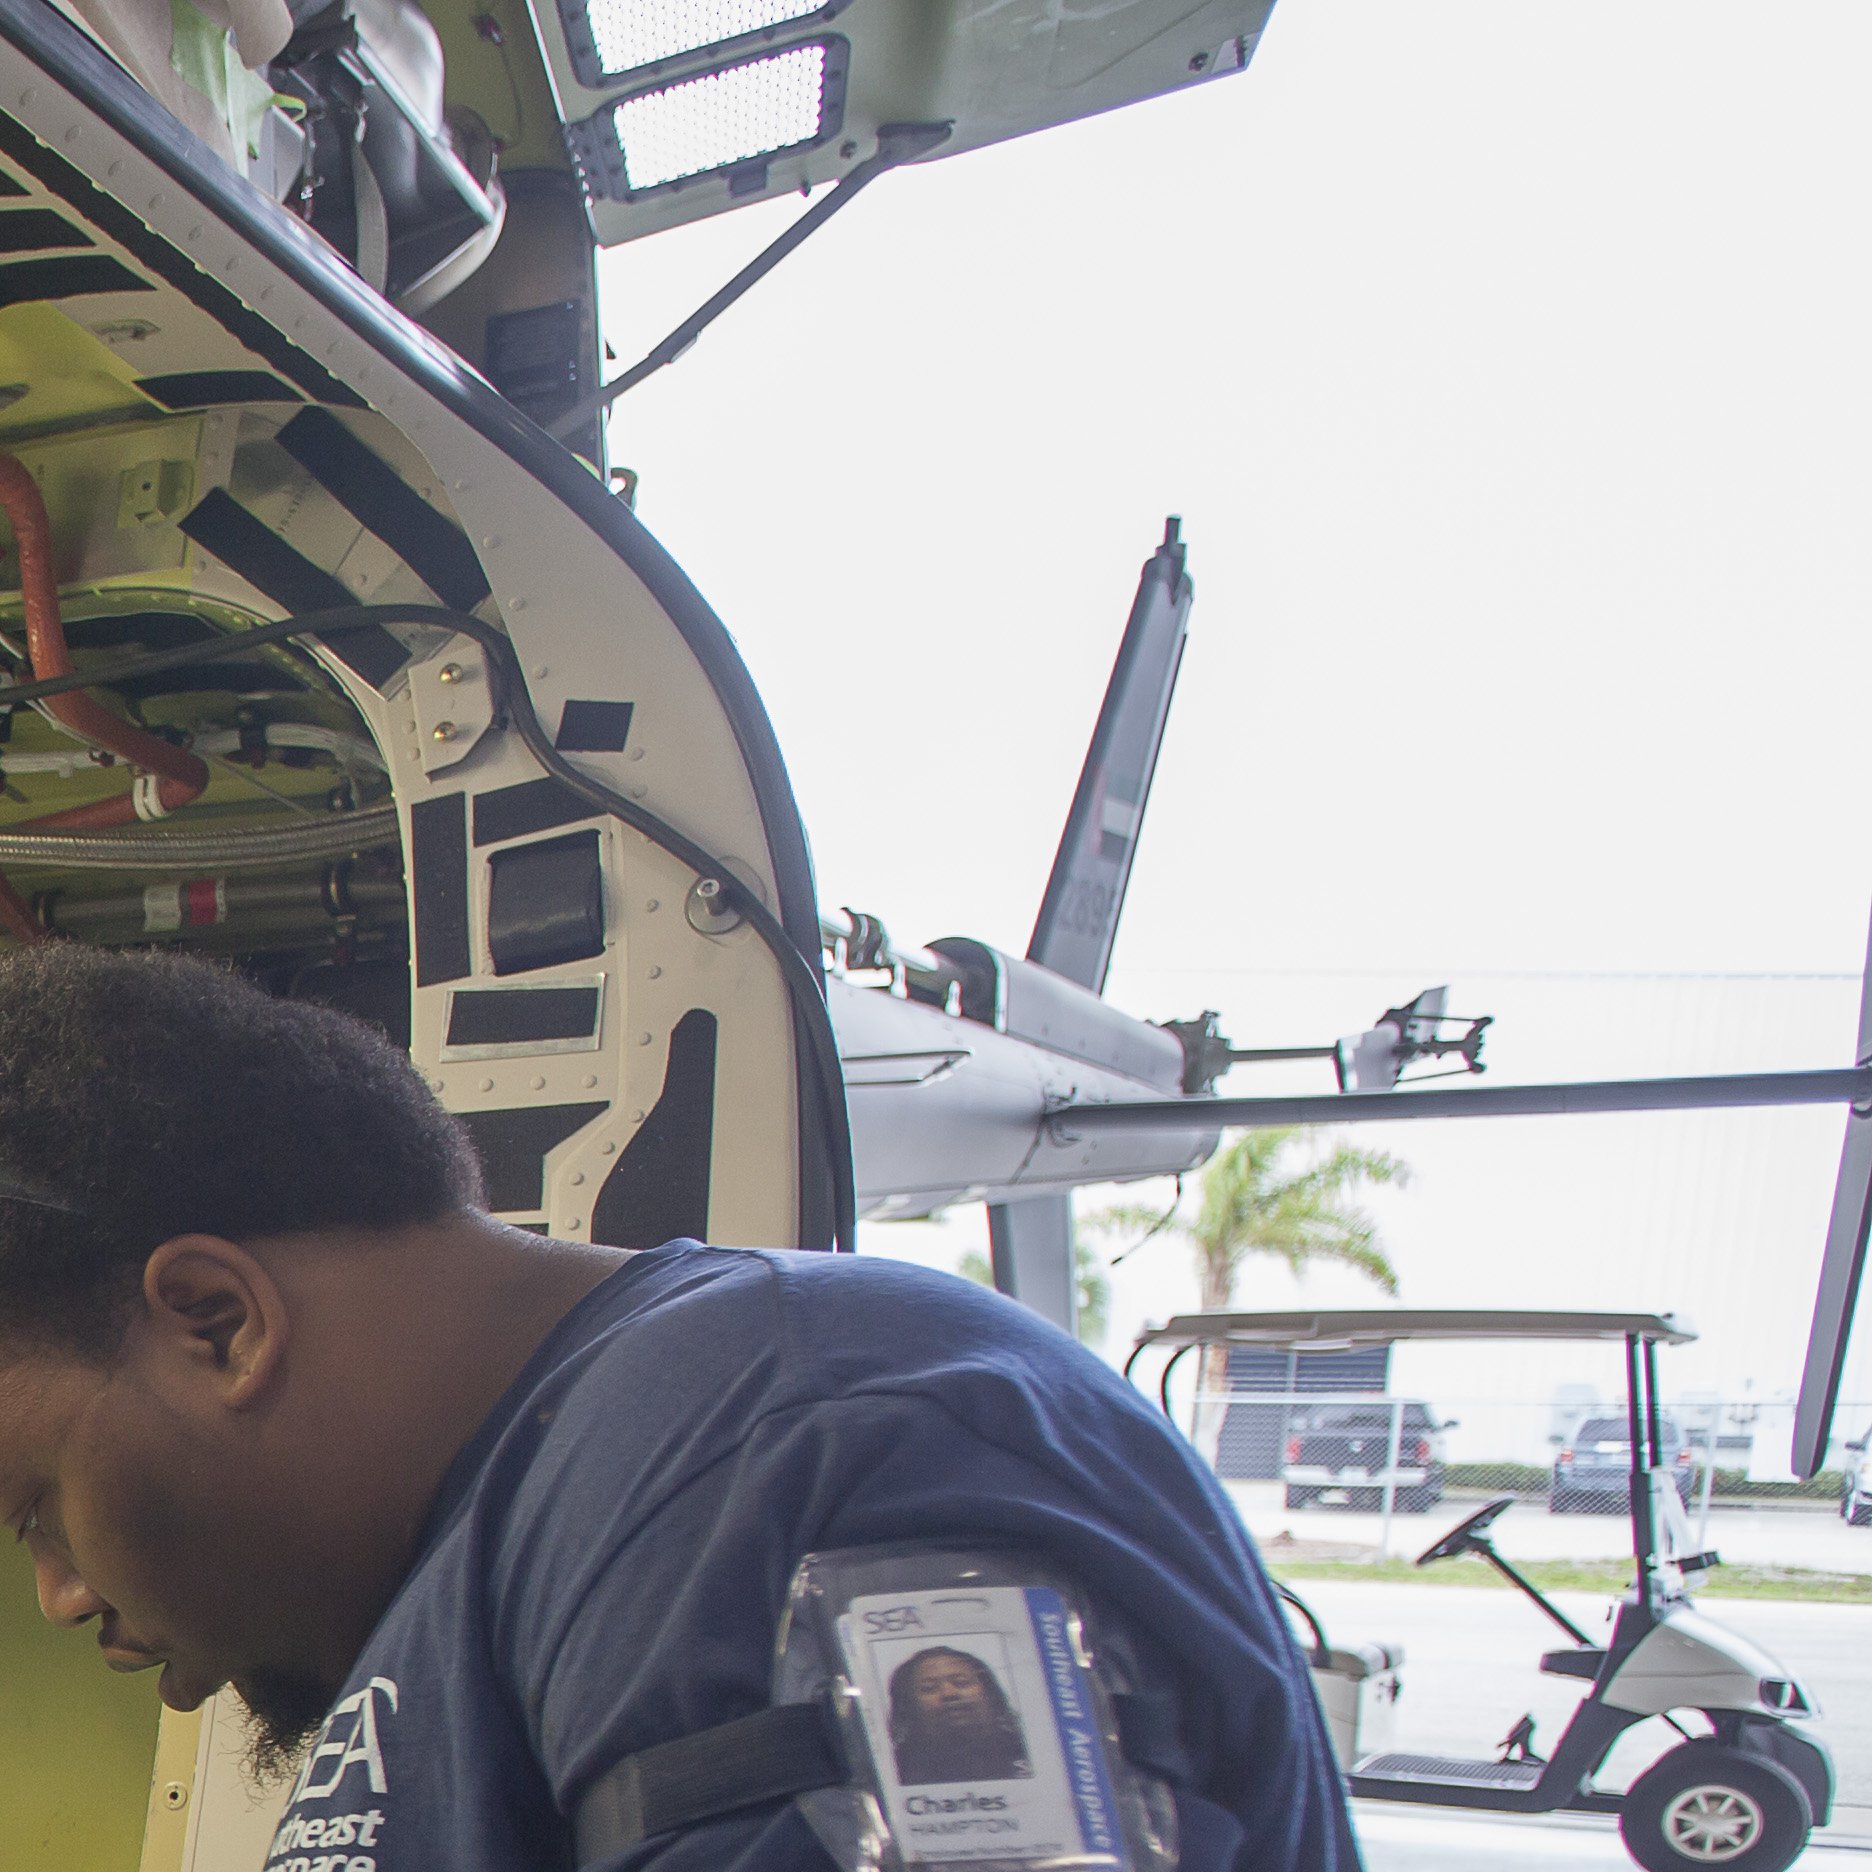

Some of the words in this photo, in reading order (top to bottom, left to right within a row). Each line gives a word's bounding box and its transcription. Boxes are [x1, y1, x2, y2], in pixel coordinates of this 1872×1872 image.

[863, 1605, 924, 1635] SEA
[905, 1790, 1008, 1816] Charles
[1067, 1728, 1114, 1849] Aerospace
[269, 1808, 387, 1860] theast
